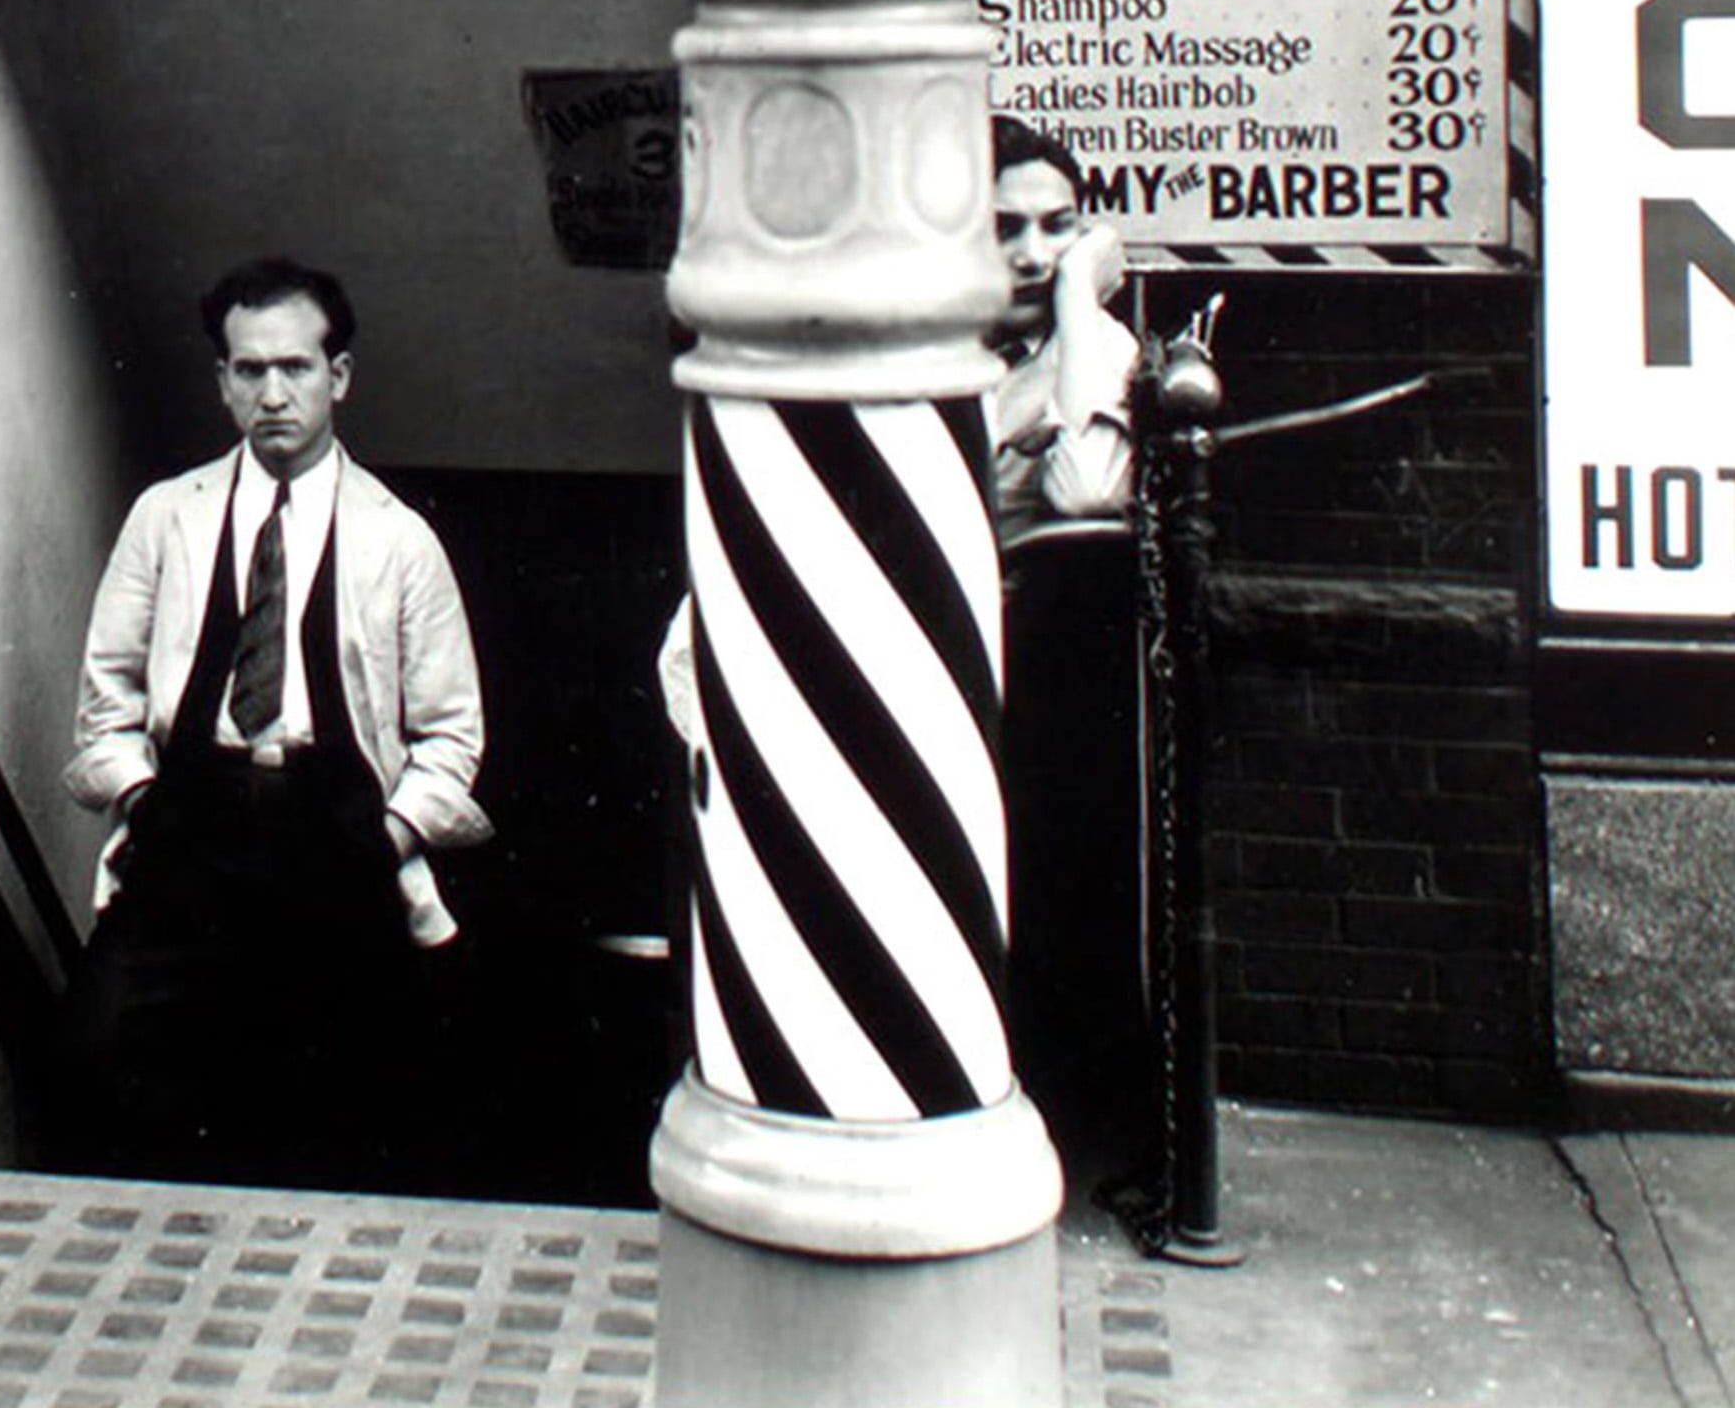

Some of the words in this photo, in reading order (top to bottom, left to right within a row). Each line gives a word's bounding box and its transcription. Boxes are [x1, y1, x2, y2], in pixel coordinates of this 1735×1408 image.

[1143, 30, 1312, 75] Massage
[988, 73, 1107, 111] Ladies
[1117, 74, 1256, 109] Hairbob
[1388, 69, 1482, 106] 30¢
[1125, 118, 1230, 153] Buster
[1238, 118, 1337, 152] Brown
[1388, 111, 1487, 152] 30¢
[1165, 162, 1205, 199] THE
[1210, 164, 1450, 220] BARBER
